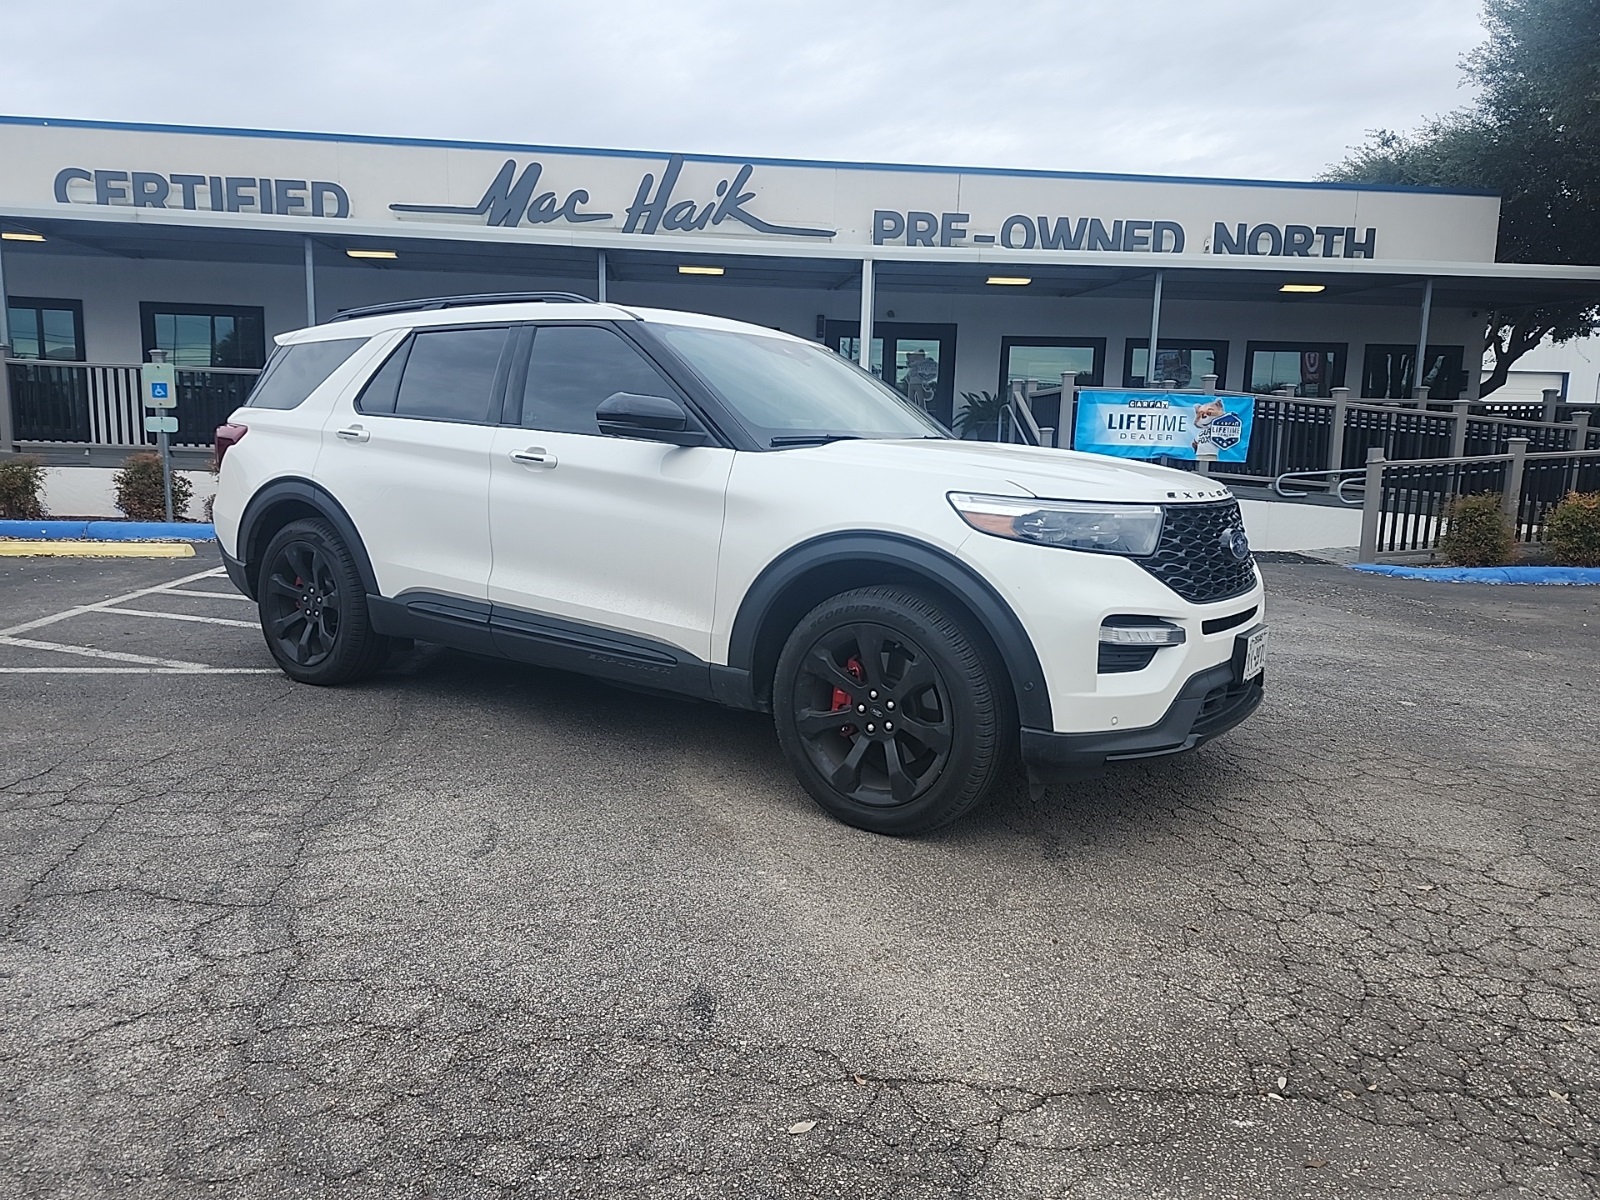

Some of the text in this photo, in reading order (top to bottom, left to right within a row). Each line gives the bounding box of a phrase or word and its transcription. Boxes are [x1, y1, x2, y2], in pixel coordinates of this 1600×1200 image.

[54, 167, 351, 218] CERTIFIED
[621, 153, 837, 235] Haik
[873, 209, 1378, 259] PRE-OWNED NORTH
[1128, 400, 1169, 409] CARFAX
[1107, 413, 1187, 432] LIFETIME
[1119, 433, 1173, 441] DEALER
